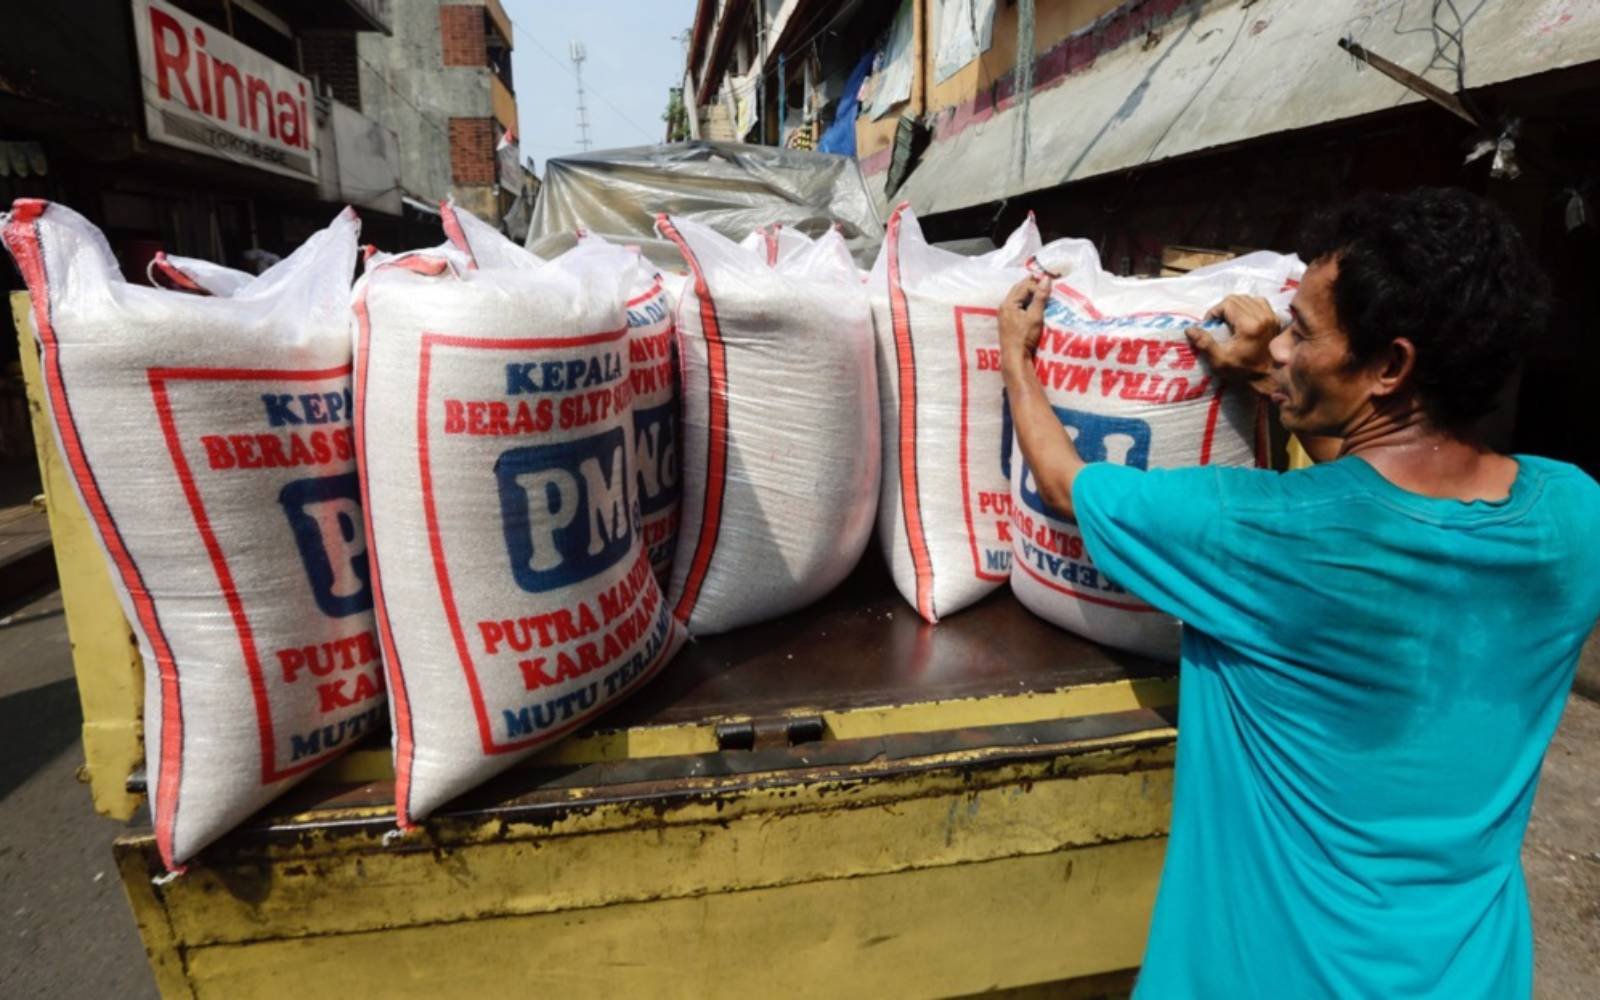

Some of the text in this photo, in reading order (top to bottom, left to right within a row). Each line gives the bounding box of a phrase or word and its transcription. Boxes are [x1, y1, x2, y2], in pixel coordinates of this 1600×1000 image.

[149, 5, 309, 149] Rinnai
[505, 352, 622, 395] KEPALA
[1101, 369, 1211, 404] PUTRA
[444, 400, 553, 436] BERAS
[559, 388, 611, 430] SLYP
[201, 430, 333, 471] BERAS
[515, 446, 628, 572] PM
[1036, 525, 1082, 559] SLYP
[478, 602, 600, 654] PUTRA
[503, 681, 598, 738] MUTU
